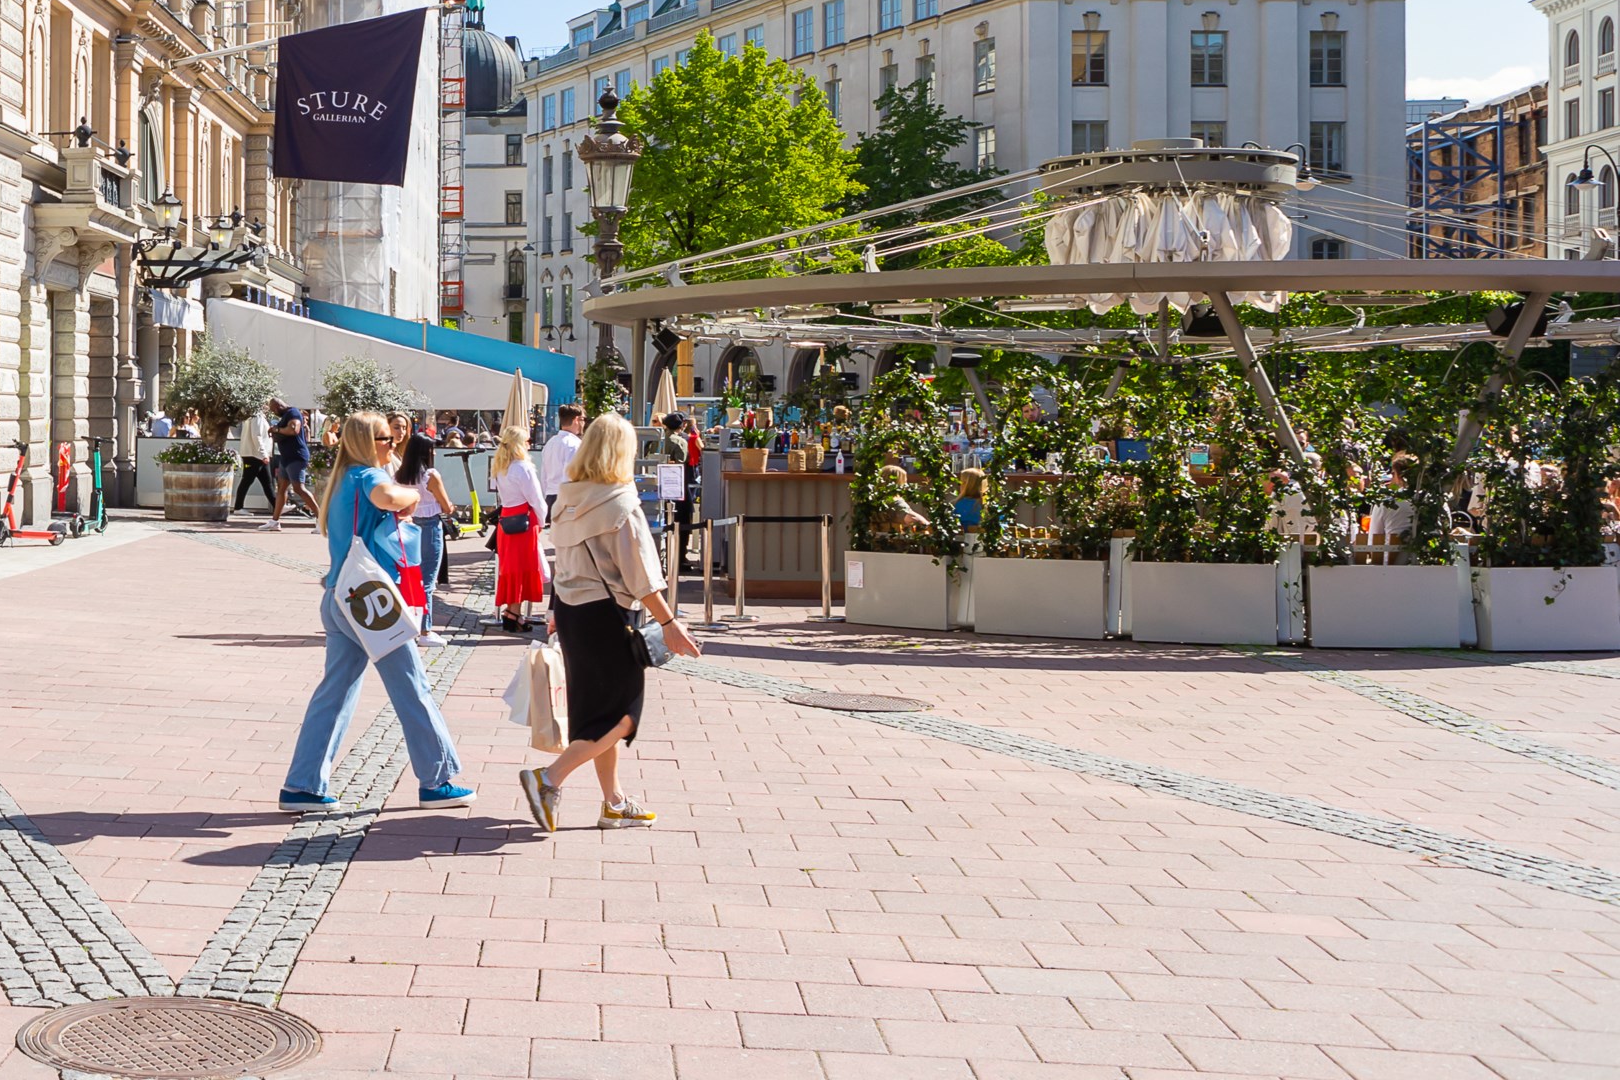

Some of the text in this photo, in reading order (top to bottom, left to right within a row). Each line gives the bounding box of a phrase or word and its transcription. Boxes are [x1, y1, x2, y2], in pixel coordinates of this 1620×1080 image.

[297, 90, 388, 121] STURE
[313, 113, 366, 123] GALLERIAN
[363, 587, 394, 626] JD
